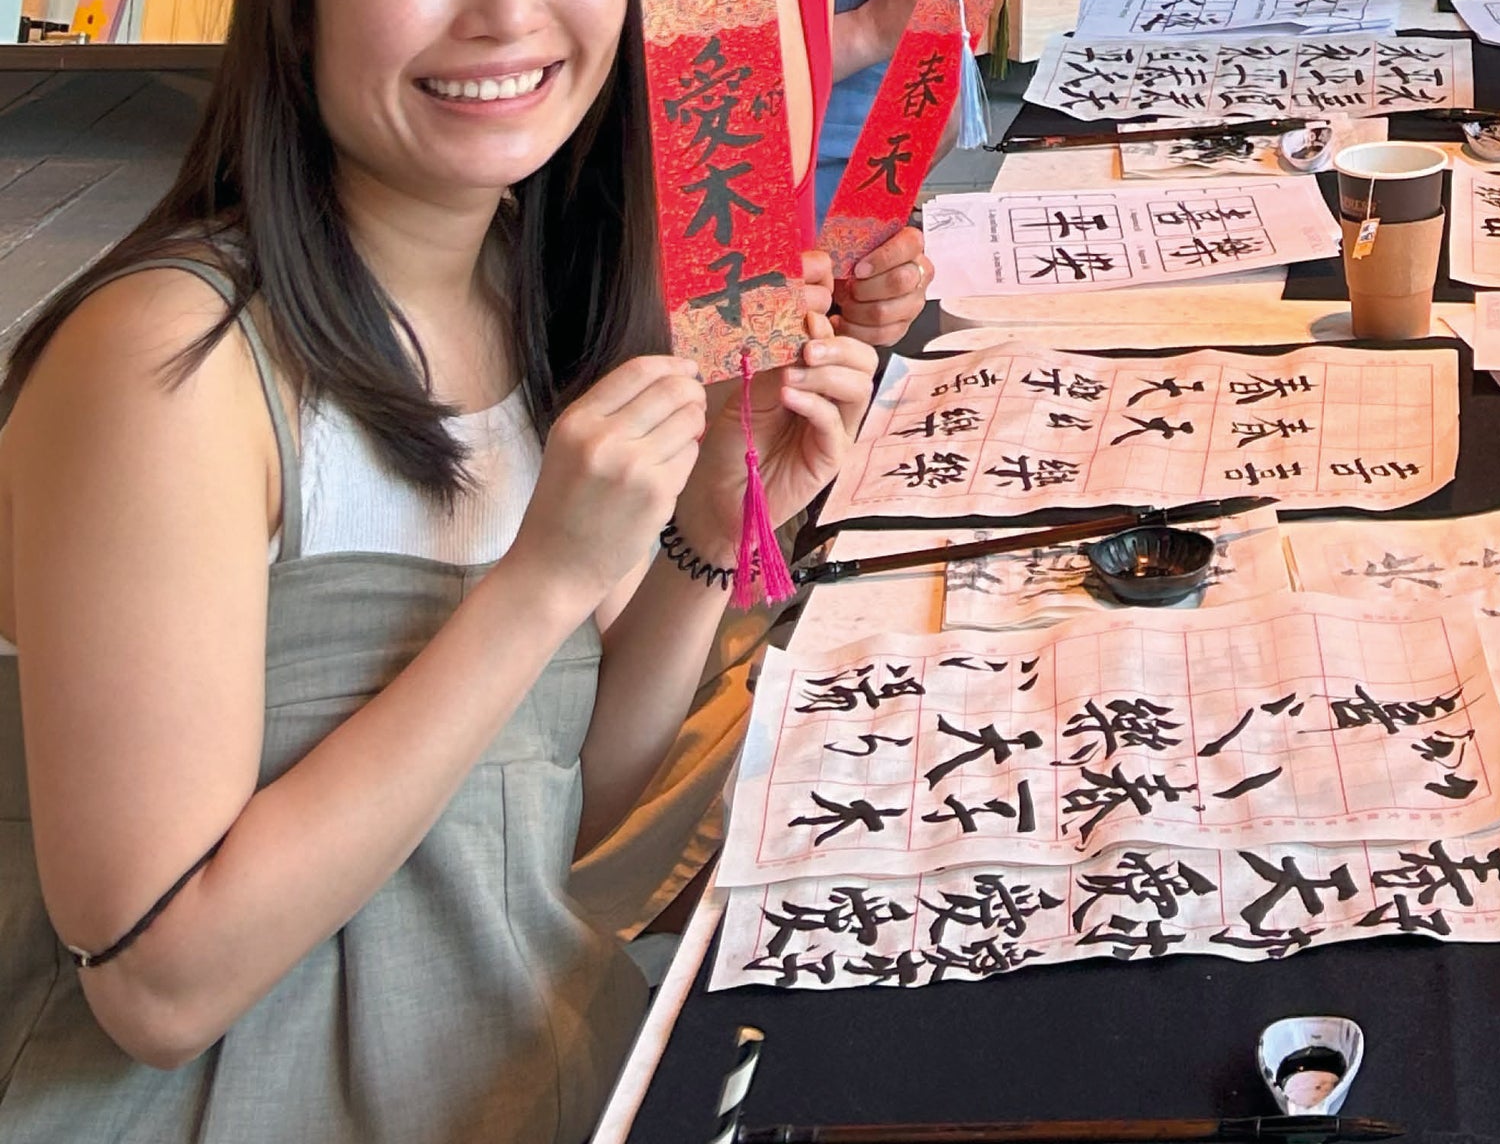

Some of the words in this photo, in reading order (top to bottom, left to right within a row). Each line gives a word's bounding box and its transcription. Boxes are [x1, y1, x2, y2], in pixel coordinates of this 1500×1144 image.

[664, 36, 786, 327] 愛木子
[856, 55, 944, 196] 春天
